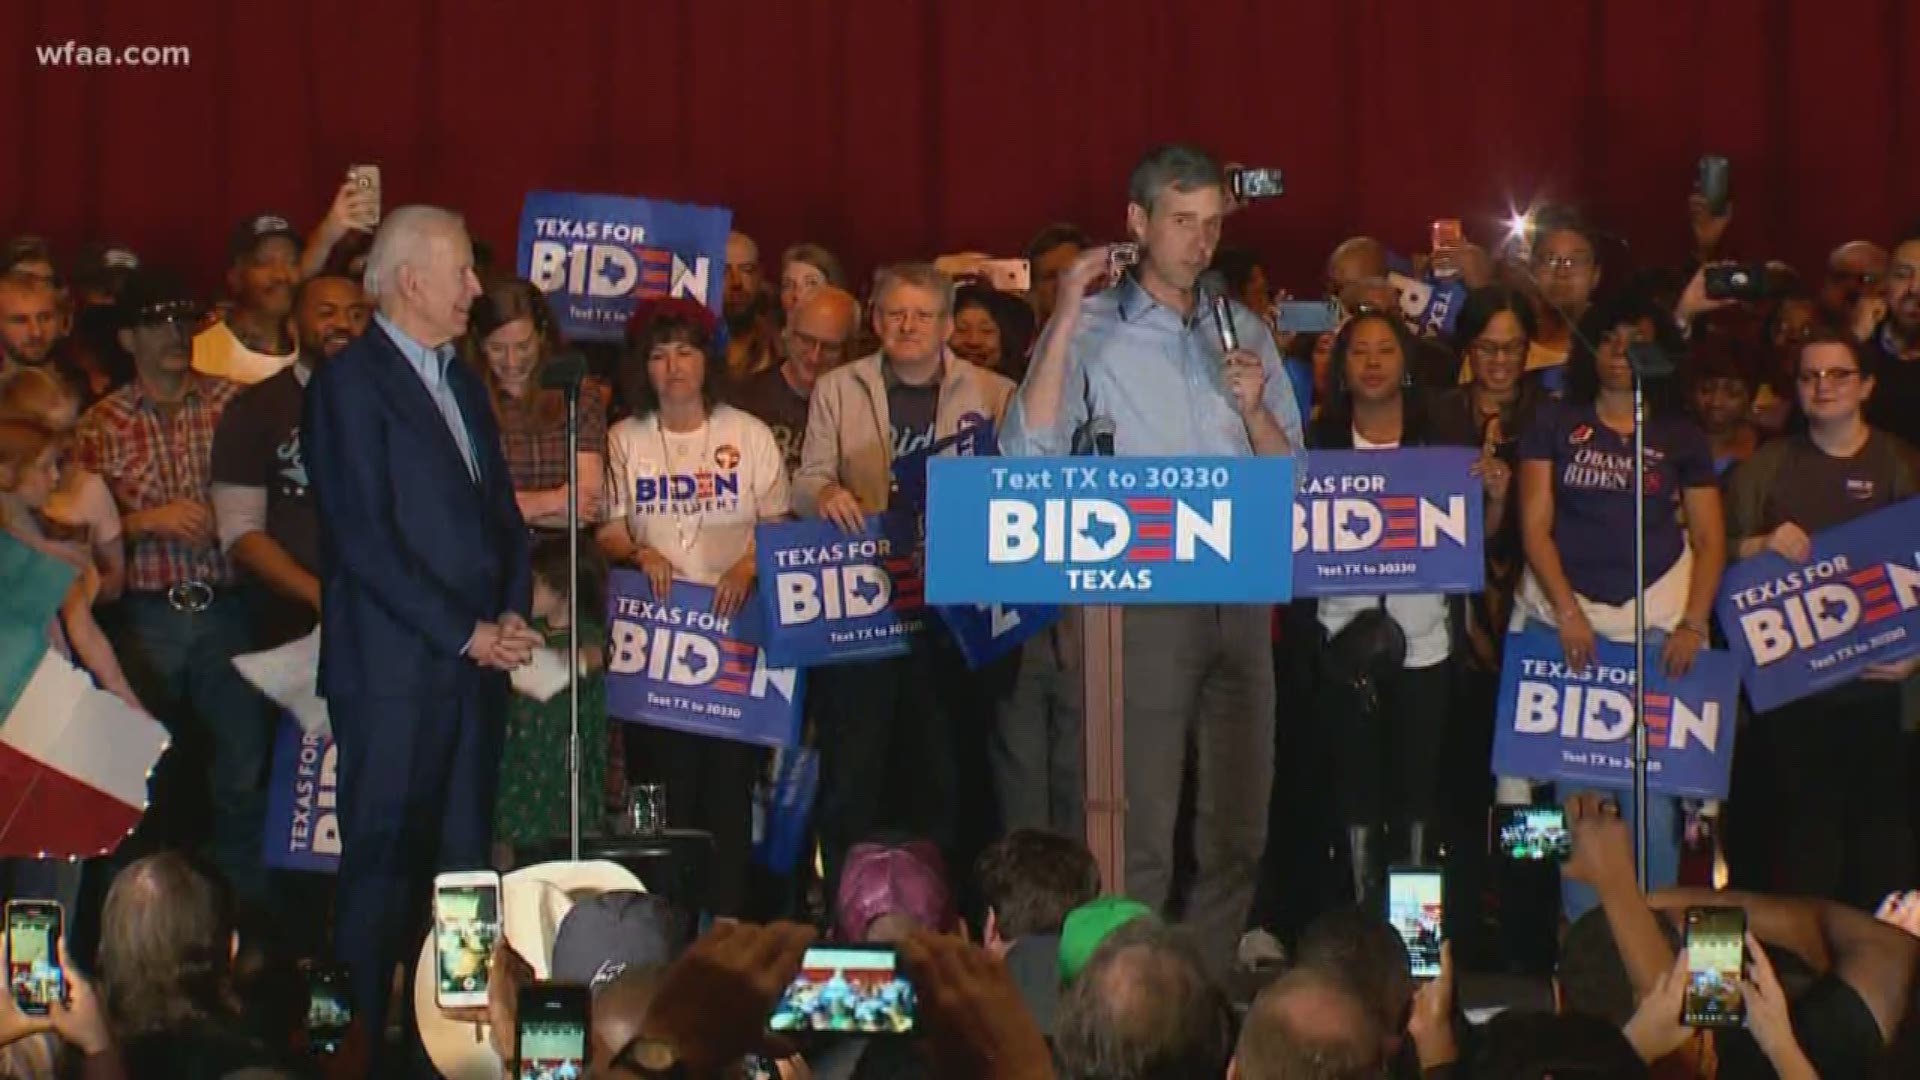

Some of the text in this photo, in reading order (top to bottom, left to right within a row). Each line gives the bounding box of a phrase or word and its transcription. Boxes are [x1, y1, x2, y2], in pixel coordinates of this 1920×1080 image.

[535, 217, 645, 243] TEXAS FOR
[530, 240, 710, 306] BIDEN
[1563, 462, 1629, 490] BIDEN
[1574, 447, 1634, 470] OBAM
[635, 468, 738, 503] BIDEN
[992, 466, 1230, 491] Text TX to 30330
[1341, 474, 1386, 494] FOR
[988, 497, 1232, 564] BIDEN
[1292, 494, 1466, 553] BIDEN
[774, 539, 891, 567] TEXAS FOR
[1065, 568, 1153, 591] TEXAS
[1732, 554, 1850, 611] TEXAS FOR
[618, 597, 731, 634] TEXAS FOR
[608, 618, 797, 704] BIDEN
[1514, 680, 1720, 754] BIDEN
[290, 732, 319, 852] TEXAS FOR
